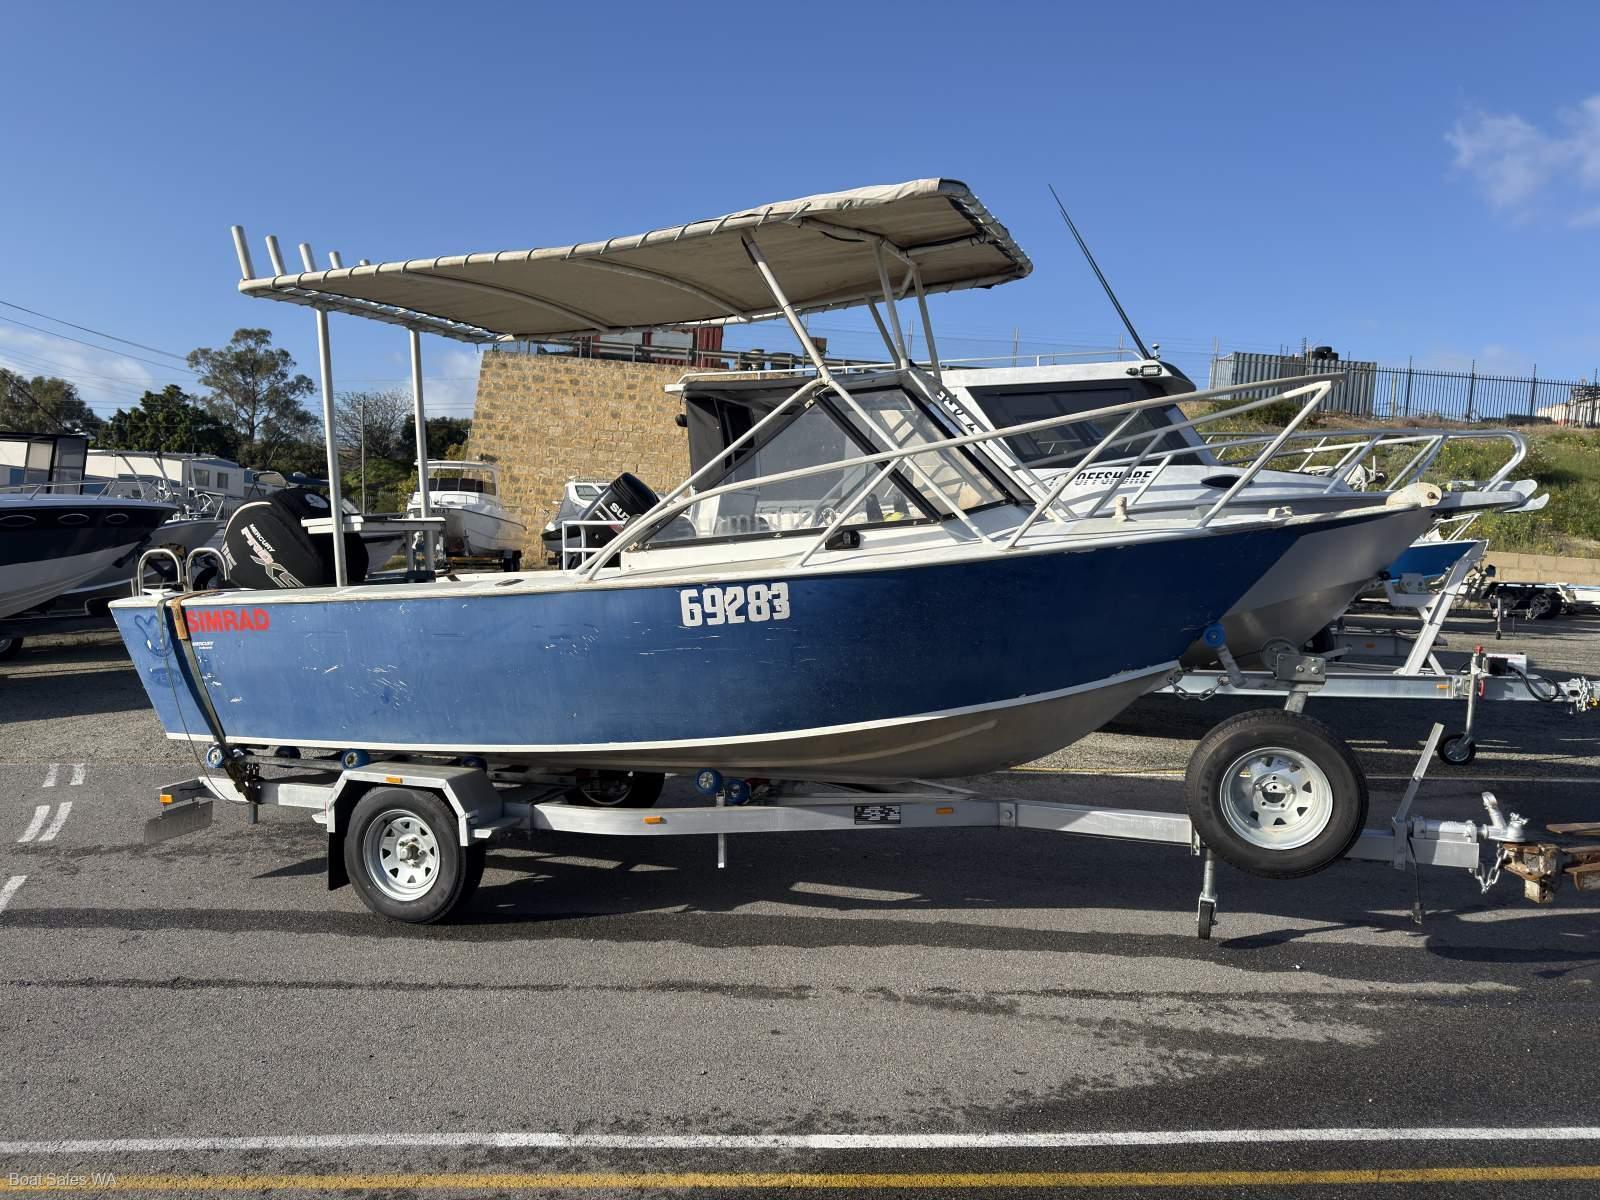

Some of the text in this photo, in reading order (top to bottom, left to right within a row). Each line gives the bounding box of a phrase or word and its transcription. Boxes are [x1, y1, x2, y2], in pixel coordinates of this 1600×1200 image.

[609, 502, 631, 522] SUZ
[249, 523, 276, 552] MERCURY
[680, 582, 790, 627] 69283
[186, 608, 271, 633] SIMRAD
